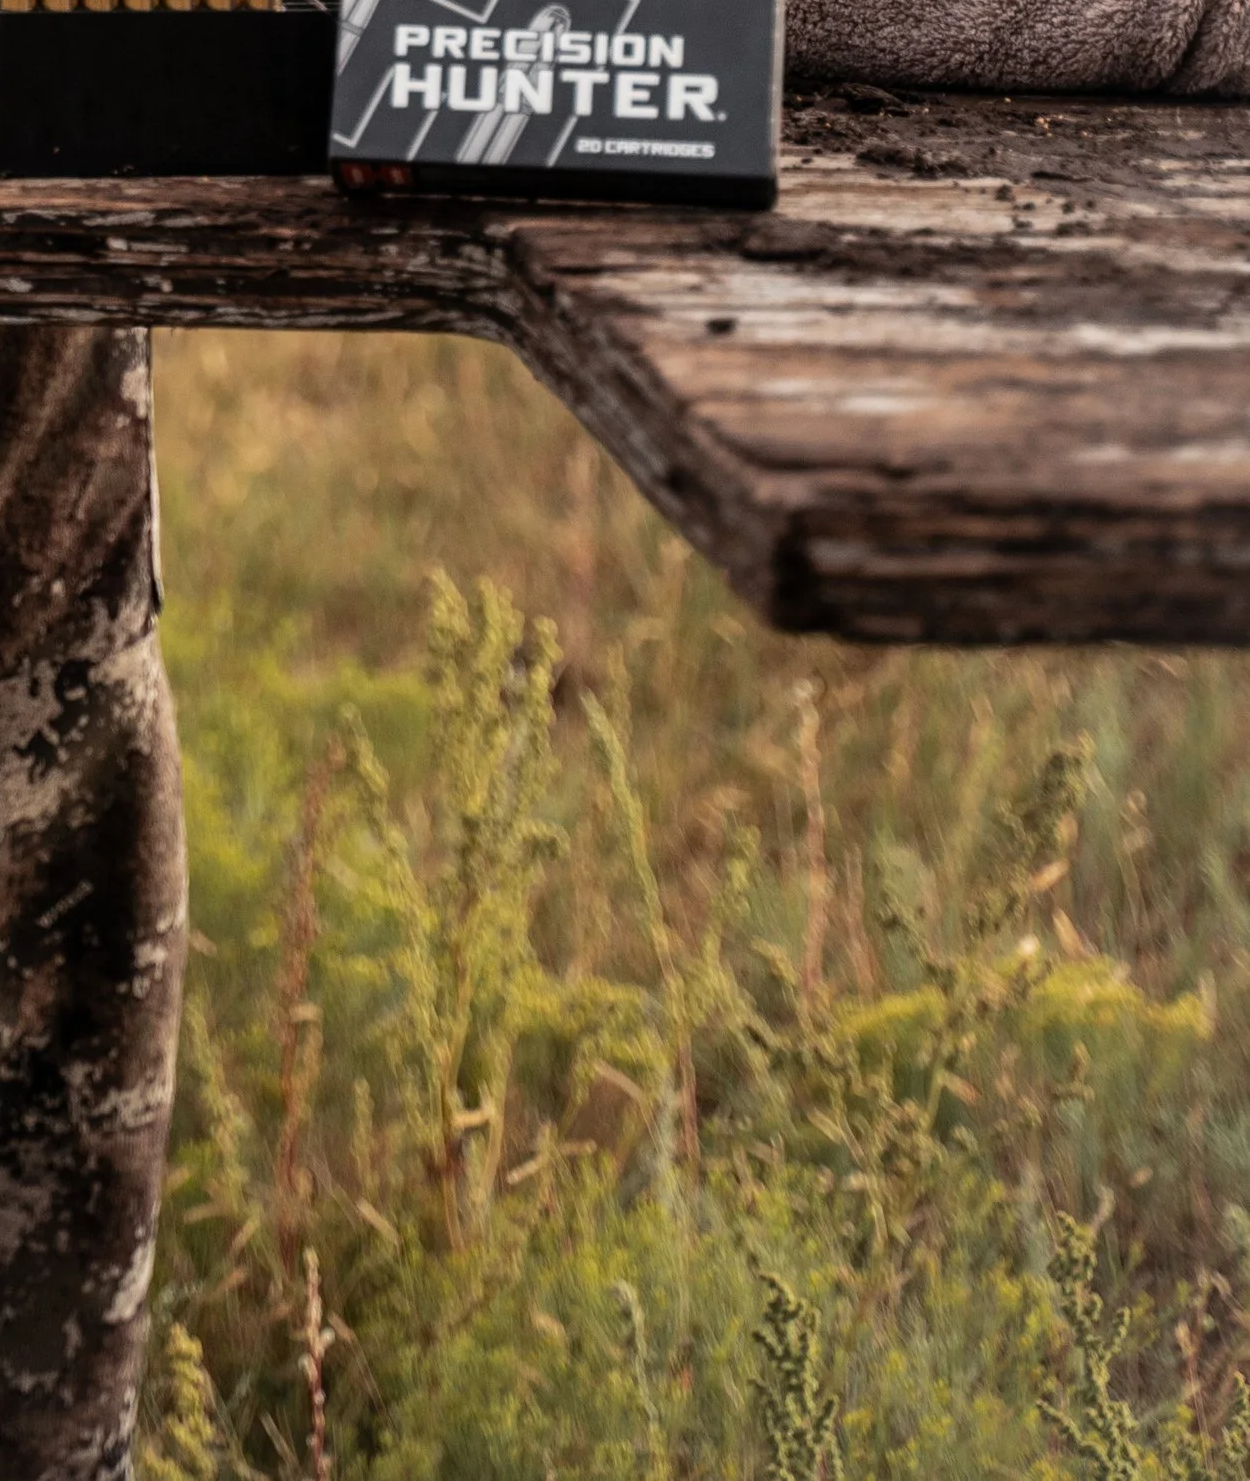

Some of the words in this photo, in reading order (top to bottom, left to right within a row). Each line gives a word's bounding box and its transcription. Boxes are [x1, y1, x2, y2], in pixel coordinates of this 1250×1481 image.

[394, 25, 684, 68] PRECISION
[391, 63, 720, 121] HUNTER
[576, 138, 602, 154] 20
[604, 139, 716, 159] CARTRIDGES
